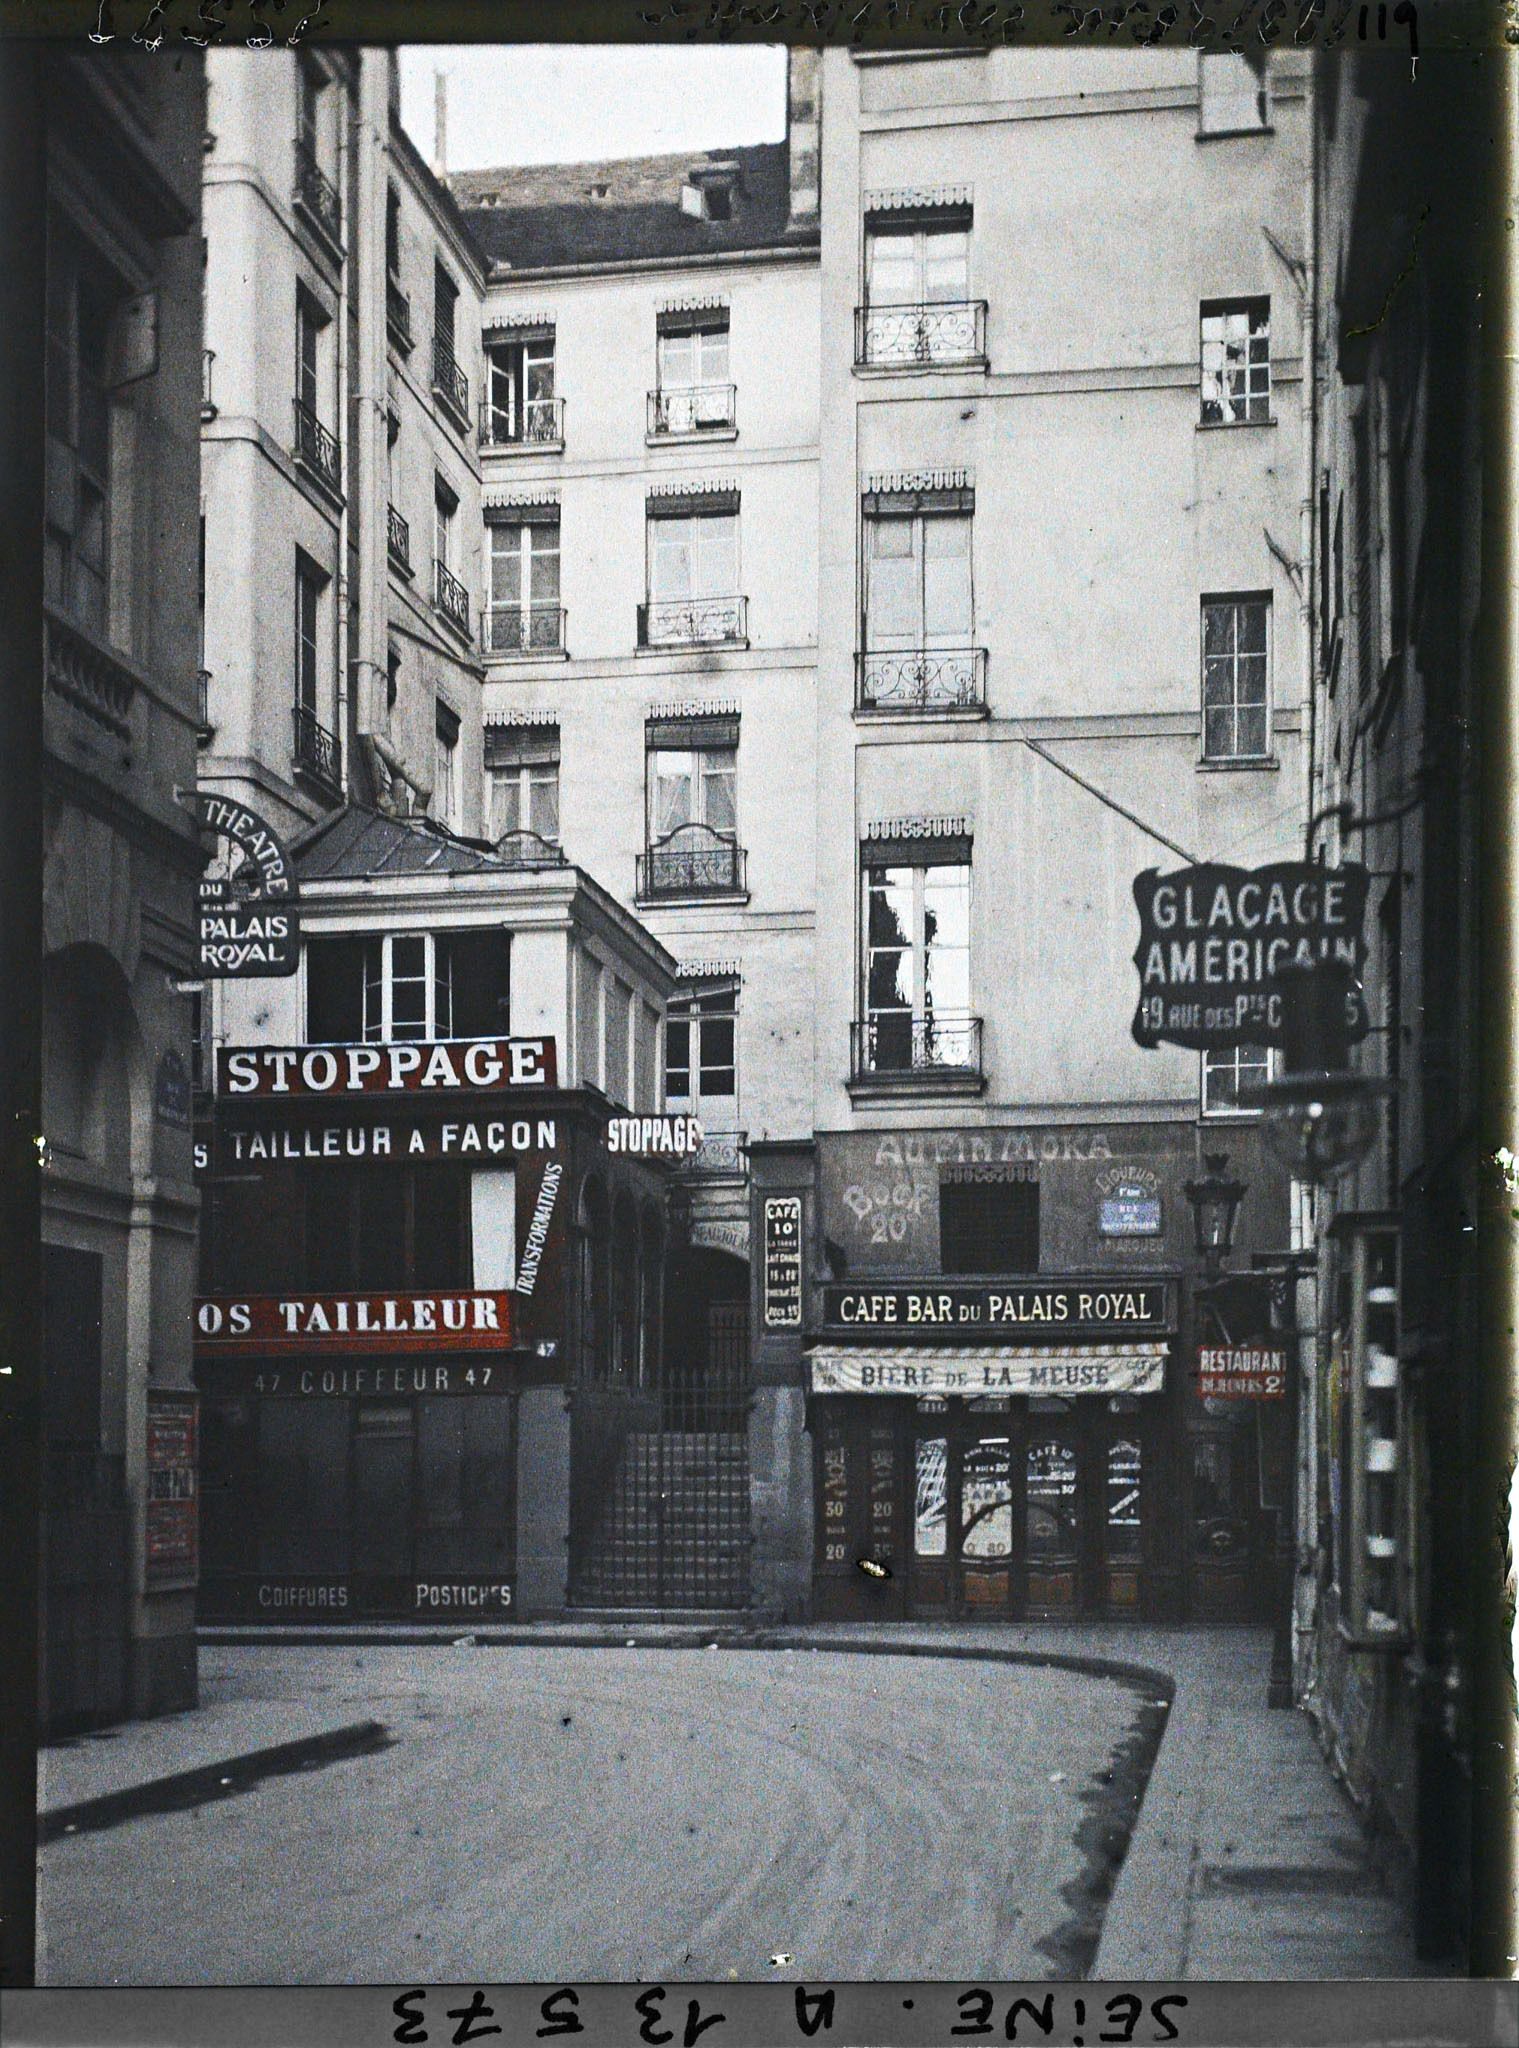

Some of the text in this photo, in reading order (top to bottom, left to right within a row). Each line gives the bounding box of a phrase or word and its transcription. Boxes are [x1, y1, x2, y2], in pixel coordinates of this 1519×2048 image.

[1151, 881, 1346, 929] GLACAGE
[200, 916, 288, 939] PALAIS
[200, 943, 286, 969] ROYAL
[1141, 997, 1164, 1030] 19
[1168, 1003, 1200, 1029] RUE
[227, 1041, 546, 1093] STOPPAGE
[231, 1120, 556, 1160] TAILLEUR A FAÇON
[607, 1115, 699, 1153] STOPPAGE
[875, 1136, 925, 1165] AU
[1001, 1133, 1113, 1162] MOKA
[515, 1161, 563, 1296] TRANSFORMATIONS
[279, 1297, 500, 1334] TAILLEUR
[840, 1293, 1151, 1322] CAFE BAR DU PALAIS ROYAL
[536, 1340, 555, 1357] 47
[254, 1366, 492, 1394] 47 COIFFEUR 47
[982, 1367, 1012, 1387] LA
[1028, 1365, 1110, 1386] MEUSE
[259, 1585, 349, 1608] COIFFURES
